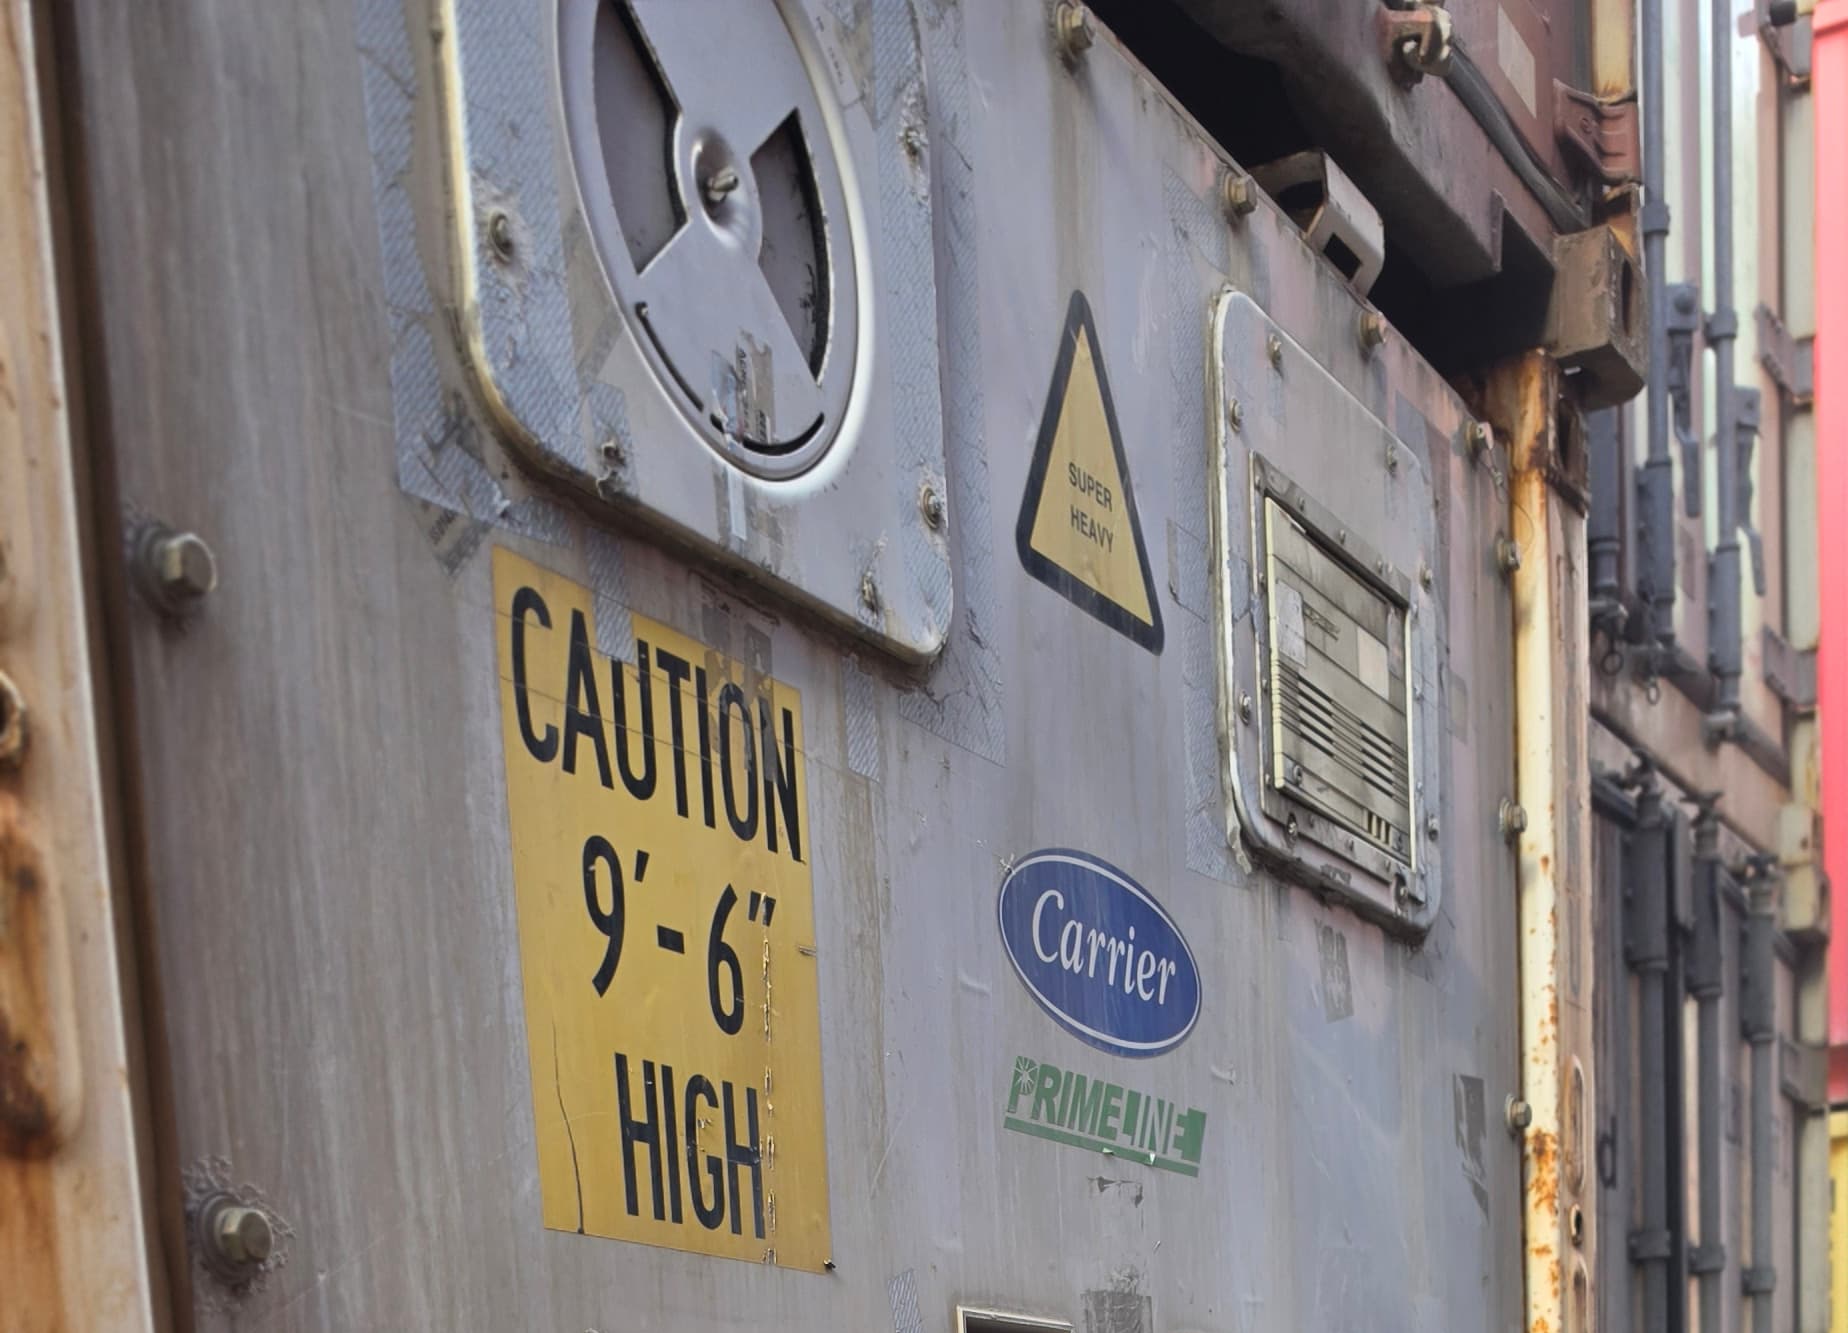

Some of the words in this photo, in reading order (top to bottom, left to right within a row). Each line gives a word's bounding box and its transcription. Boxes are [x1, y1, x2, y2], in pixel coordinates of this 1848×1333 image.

[1068, 461, 1112, 513] SUPER
[1069, 504, 1114, 553] HEAVY
[511, 585, 802, 863] CAUTION
[1031, 888, 1177, 1006] Carrier
[613, 1052, 766, 1240] HIGH
[1006, 1054, 1208, 1163] PRIMELINE
